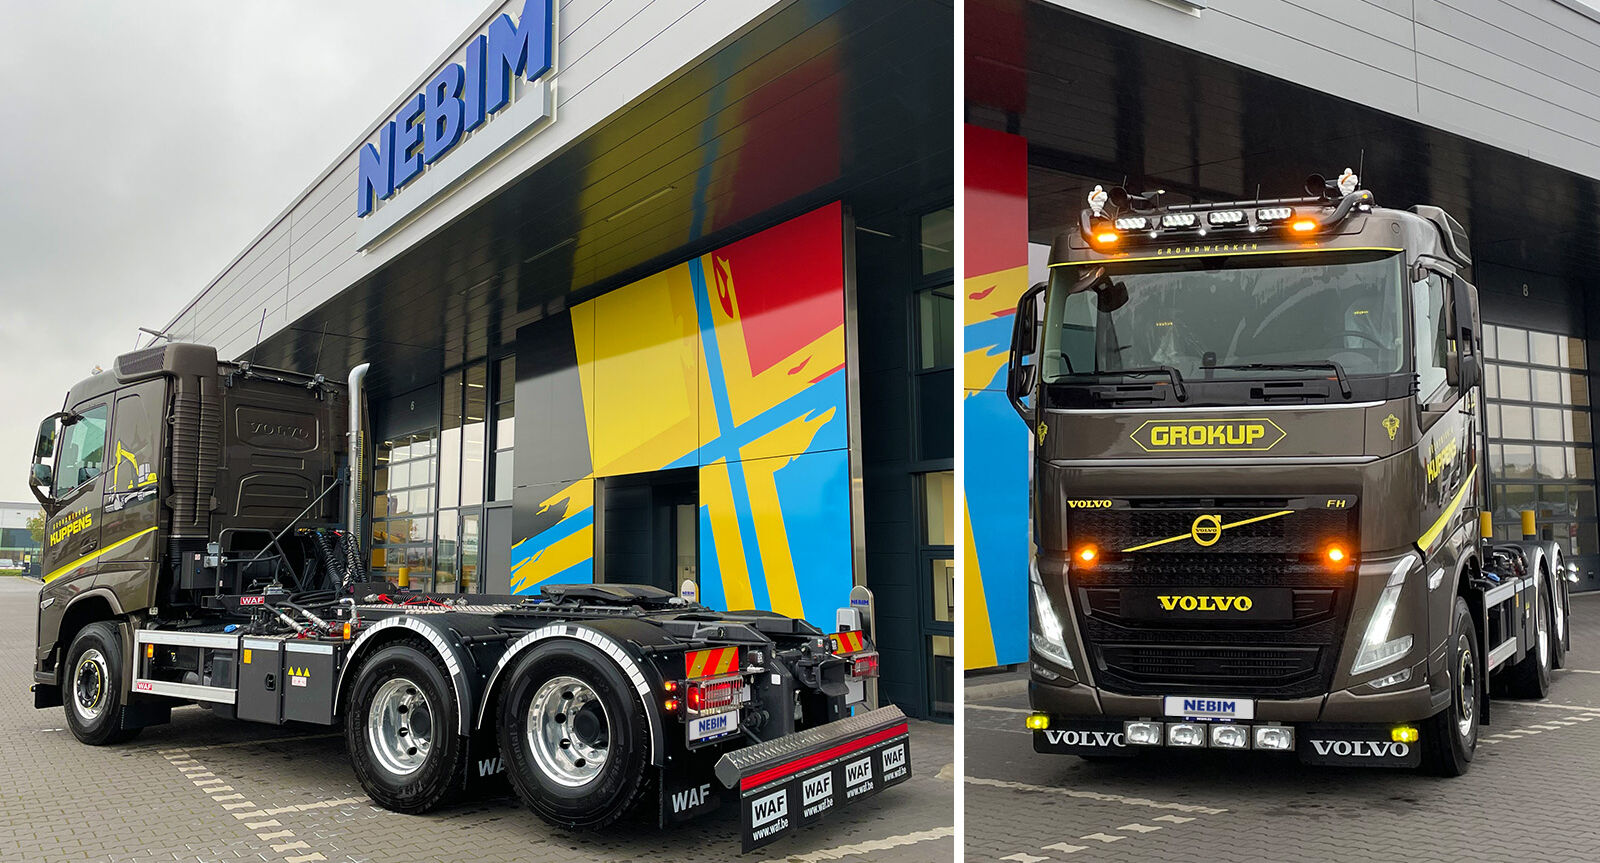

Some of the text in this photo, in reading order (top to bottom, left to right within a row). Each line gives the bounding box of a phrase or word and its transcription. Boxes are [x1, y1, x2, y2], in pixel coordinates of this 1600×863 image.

[357, 0, 553, 218] NEBIM
[1157, 243, 1258, 255] GRONDWERKEN
[1522, 283, 1529, 297] 8
[1150, 424, 1265, 446] GROKUP
[1067, 500, 1112, 508] VOLVO
[1326, 499, 1346, 508] FH
[50, 513, 93, 547] KUPPENS
[242, 596, 264, 604] WAF
[1157, 595, 1253, 611] VOLVO
[1183, 699, 1236, 713] NEBIM
[698, 714, 727, 732] NEBIM
[1309, 740, 1410, 757] VOLVO
[884, 749, 903, 767] WAF
[847, 761, 869, 782] WAF
[883, 766, 907, 782] www.waf.be
[804, 776, 830, 799] WAF
[846, 780, 874, 799] www.waf.be
[671, 783, 711, 813] WAF
[754, 795, 785, 821] WAF
[803, 798, 834, 818] www.waf.be
[752, 817, 789, 841] www.waf.be
